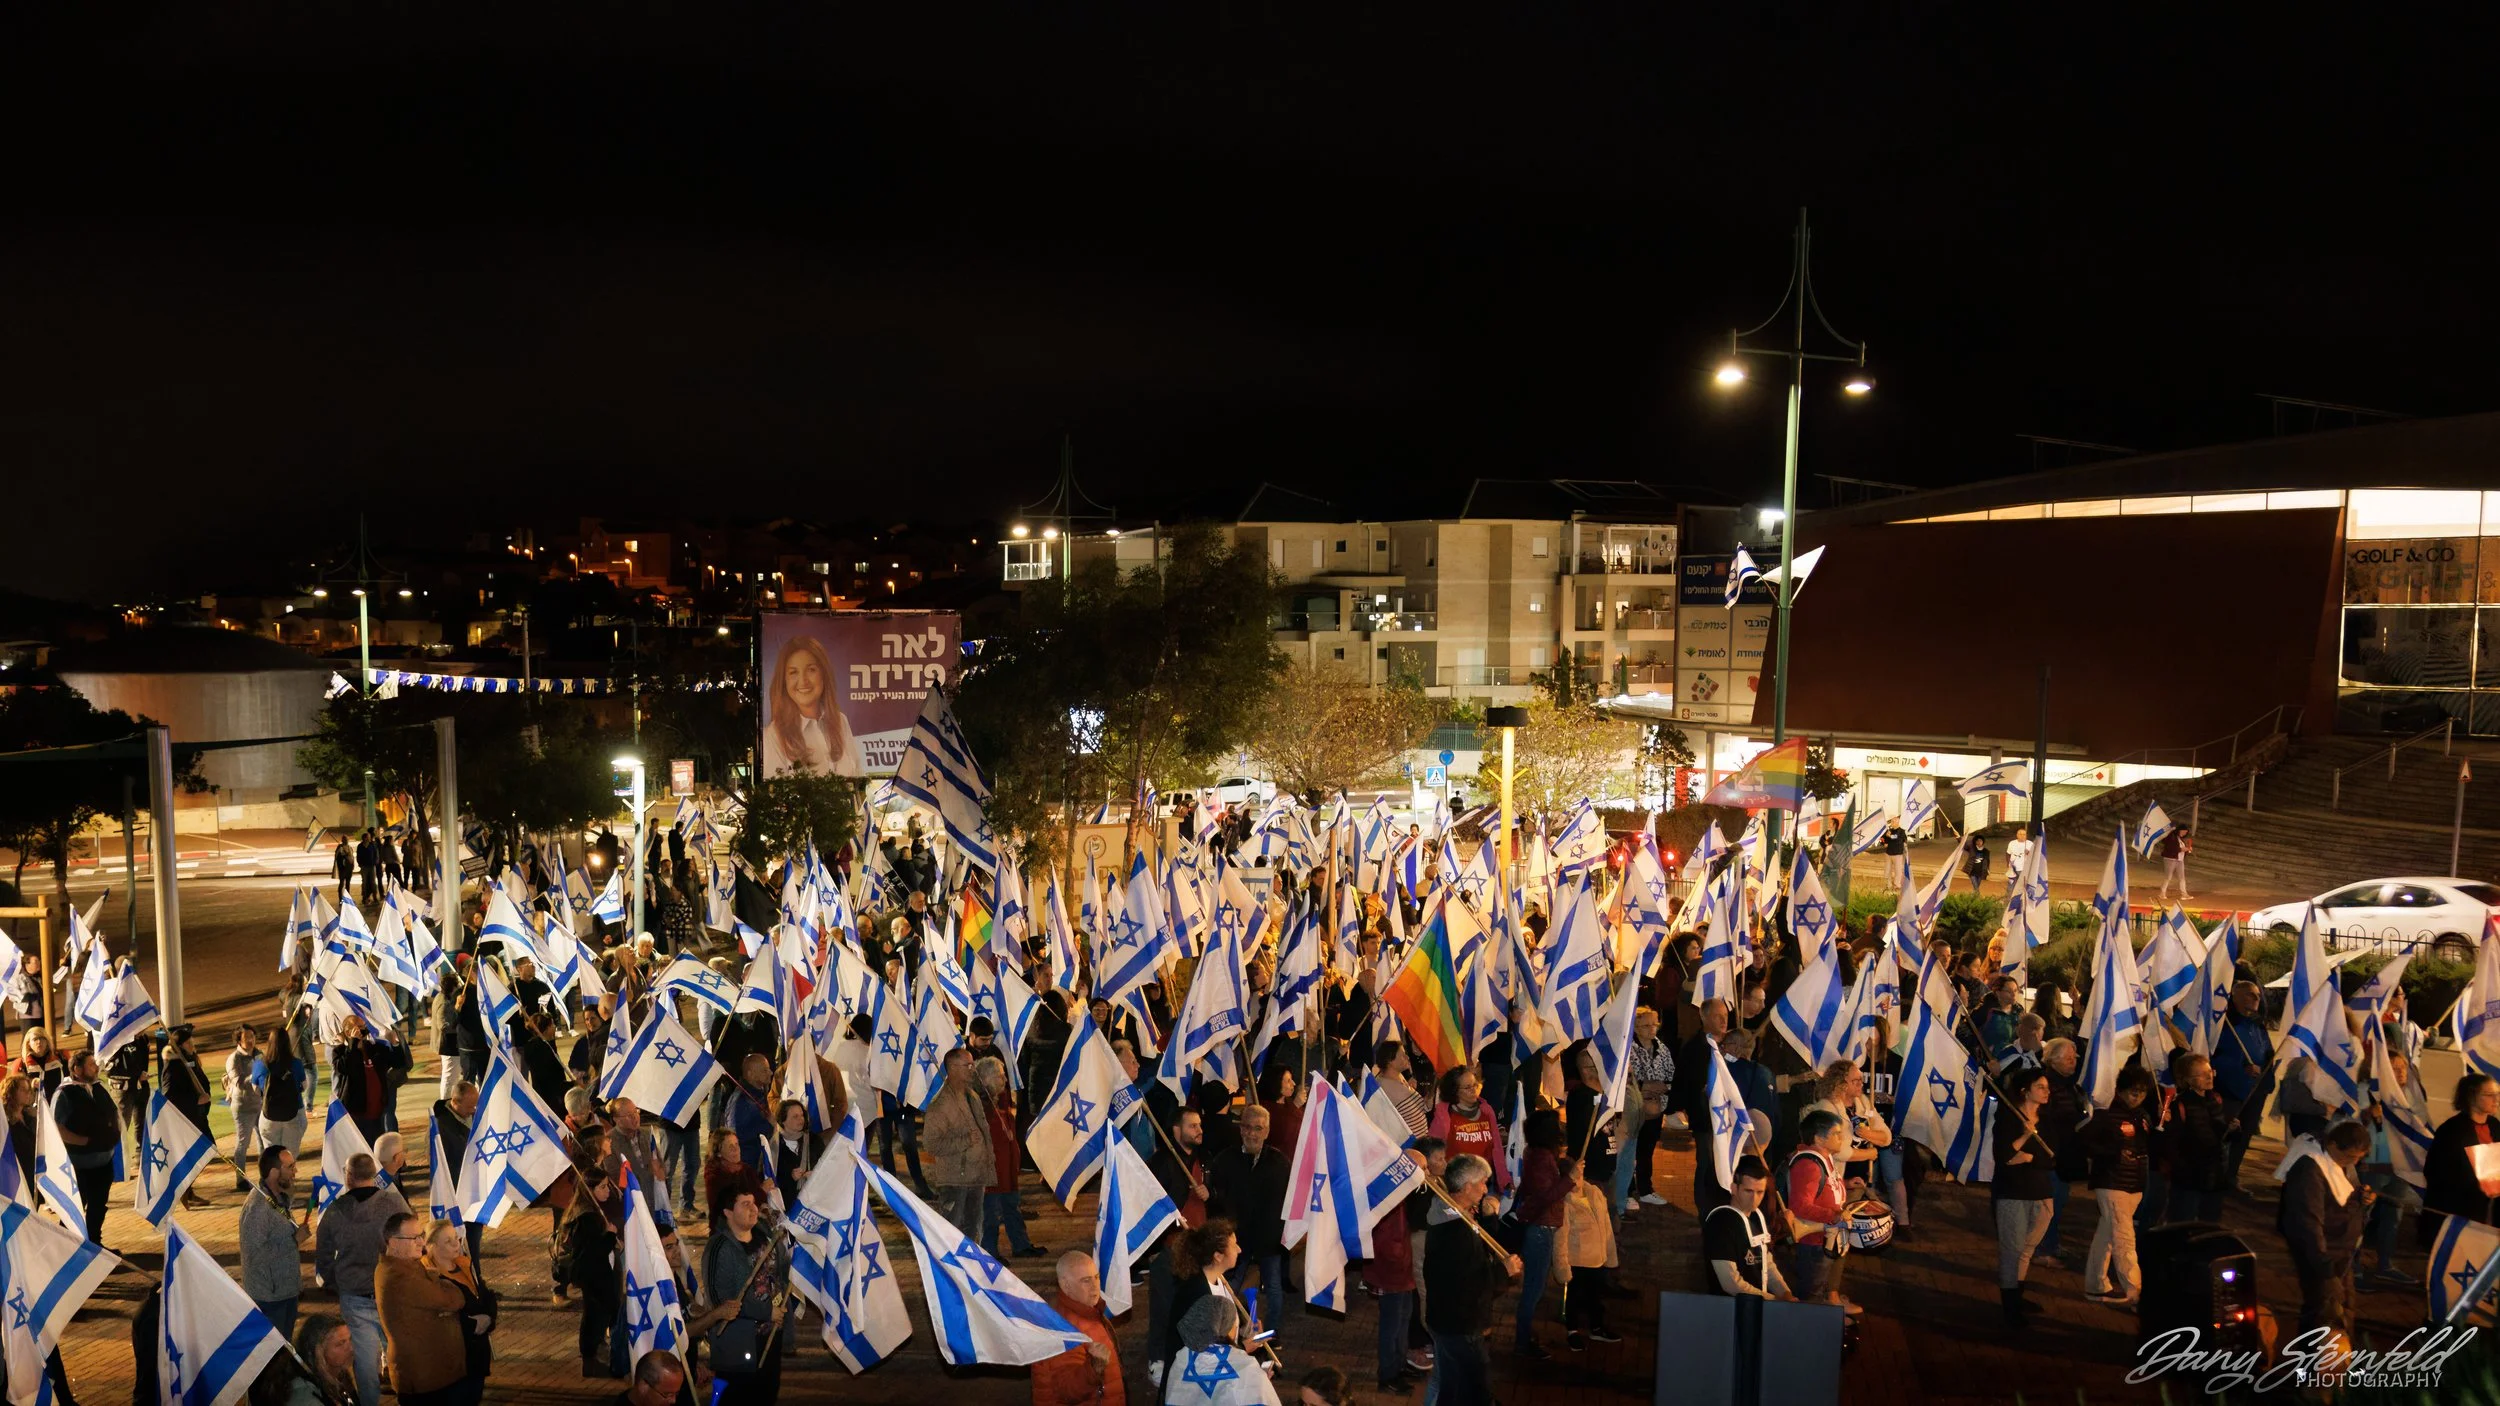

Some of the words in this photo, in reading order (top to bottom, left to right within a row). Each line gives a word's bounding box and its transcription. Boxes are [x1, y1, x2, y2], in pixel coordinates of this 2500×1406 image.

[2355, 548, 2403, 564] GOLF
[2406, 548, 2422, 563] &
[2426, 547, 2455, 563] CO
[1686, 564, 1712, 577] יקנעם
[1744, 619, 1768, 628] מכבי
[882, 627, 946, 658] לאה
[1698, 648, 1726, 658] לאומית
[850, 663, 946, 688] פדידה
[850, 692, 880, 703] יקנעם
[882, 691, 905, 700] העיר
[862, 739, 886, 751] לדרך
[1866, 755, 1899, 766] הפועלים
[1900, 756, 1917, 767] בנק
